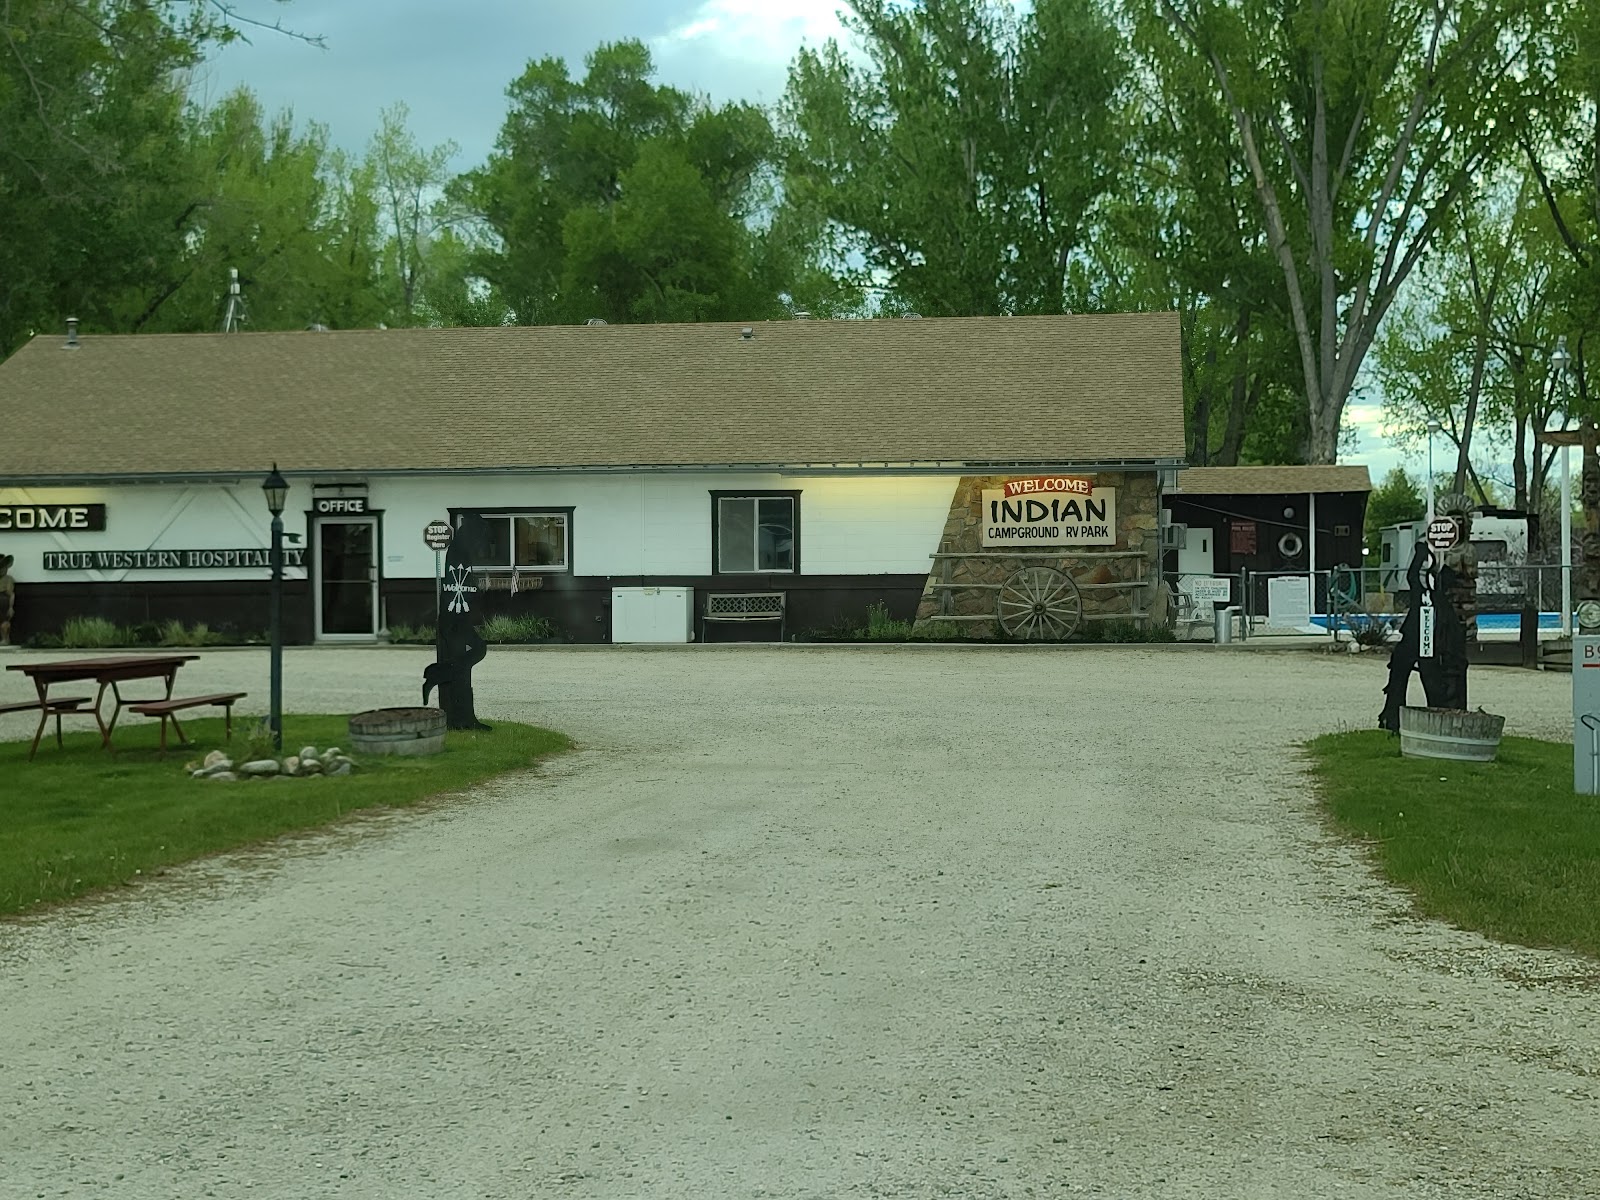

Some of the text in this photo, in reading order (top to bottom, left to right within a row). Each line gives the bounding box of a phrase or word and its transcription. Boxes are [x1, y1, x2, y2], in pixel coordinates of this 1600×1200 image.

[1007, 478, 1089, 494] WELCOME
[318, 500, 364, 513] OFFICE
[991, 499, 1106, 523] INDIAN
[428, 525, 448, 534] STOP
[988, 525, 1109, 539] CAMPGROUND RV PARK
[1431, 523, 1453, 532] STOP
[45, 549, 304, 568] TRUE WESTERN HOSPITALTY
